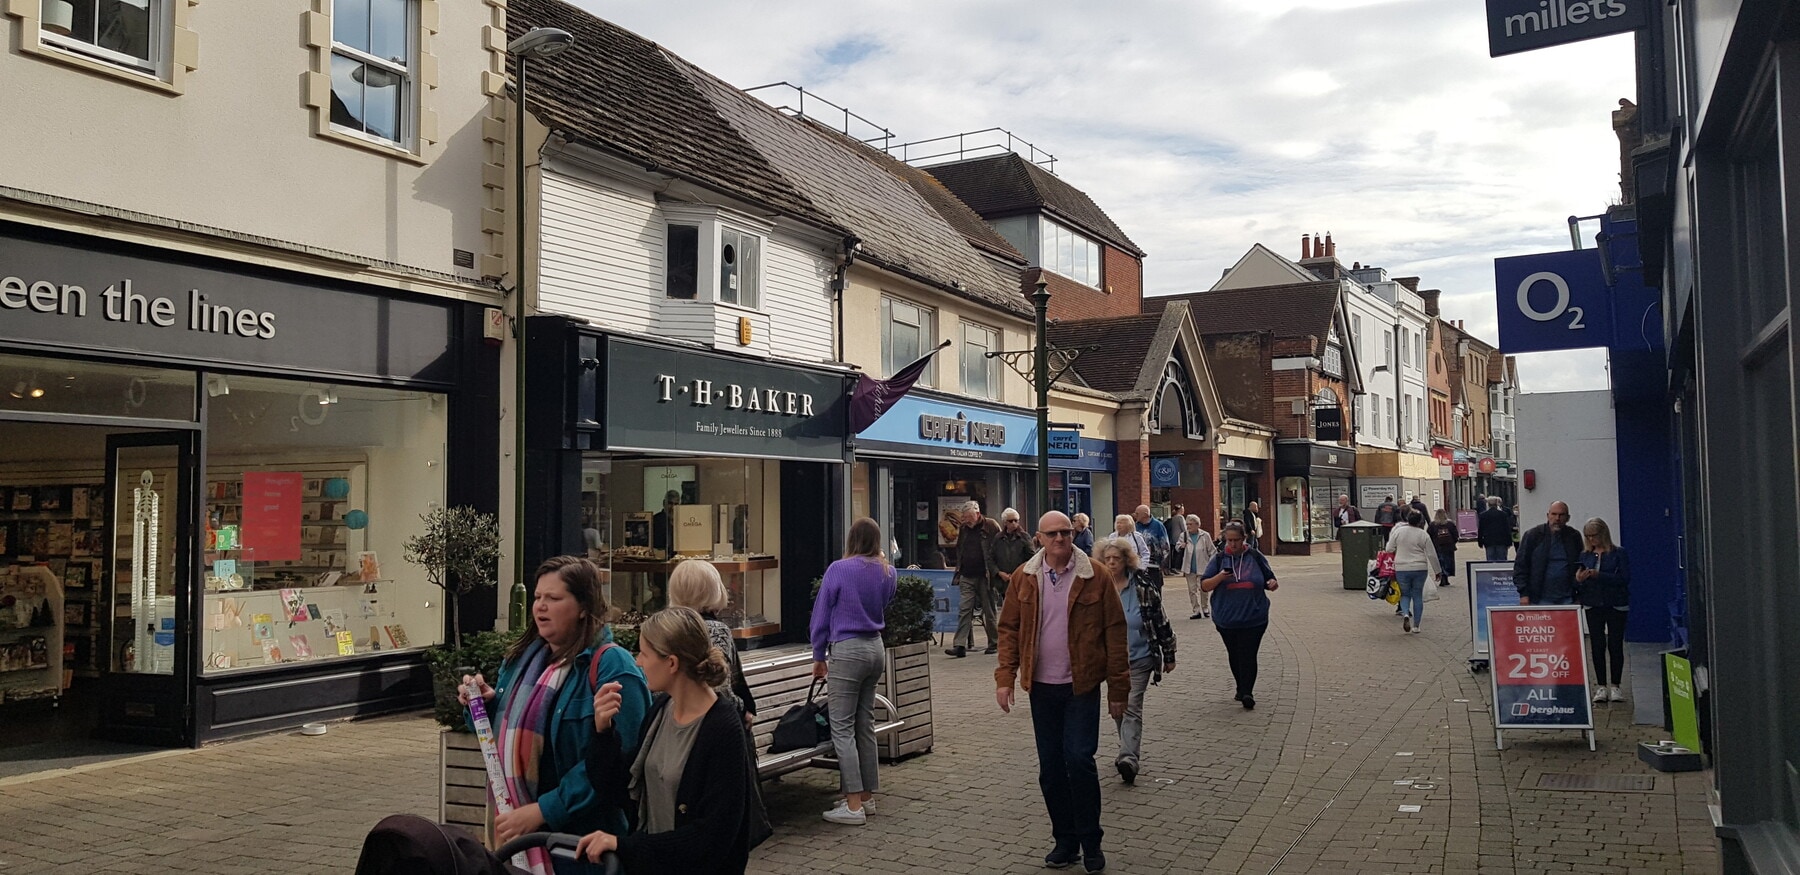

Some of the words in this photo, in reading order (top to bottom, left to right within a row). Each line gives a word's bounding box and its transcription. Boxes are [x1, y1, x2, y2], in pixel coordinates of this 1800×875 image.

[1504, 0, 1627, 37] millets
[1516, 271, 1586, 330] O2
[102, 278, 176, 326] the
[189, 288, 276, 339] lines
[696, 421, 719, 436] Family
[719, 423, 748, 436] Jewellers
[749, 427, 766, 437] Since
[767, 428, 782, 438] 1888
[920, 411, 966, 443] CAFFÈ
[970, 421, 1005, 446] NERO
[1317, 421, 1340, 429] JONES
[1048, 442, 1078, 450] NERO
[1515, 626, 1556, 635] BRAND
[1518, 635, 1555, 643] EVENT
[1526, 689, 1557, 701] ALL
[1530, 706, 1575, 716] berghaus
